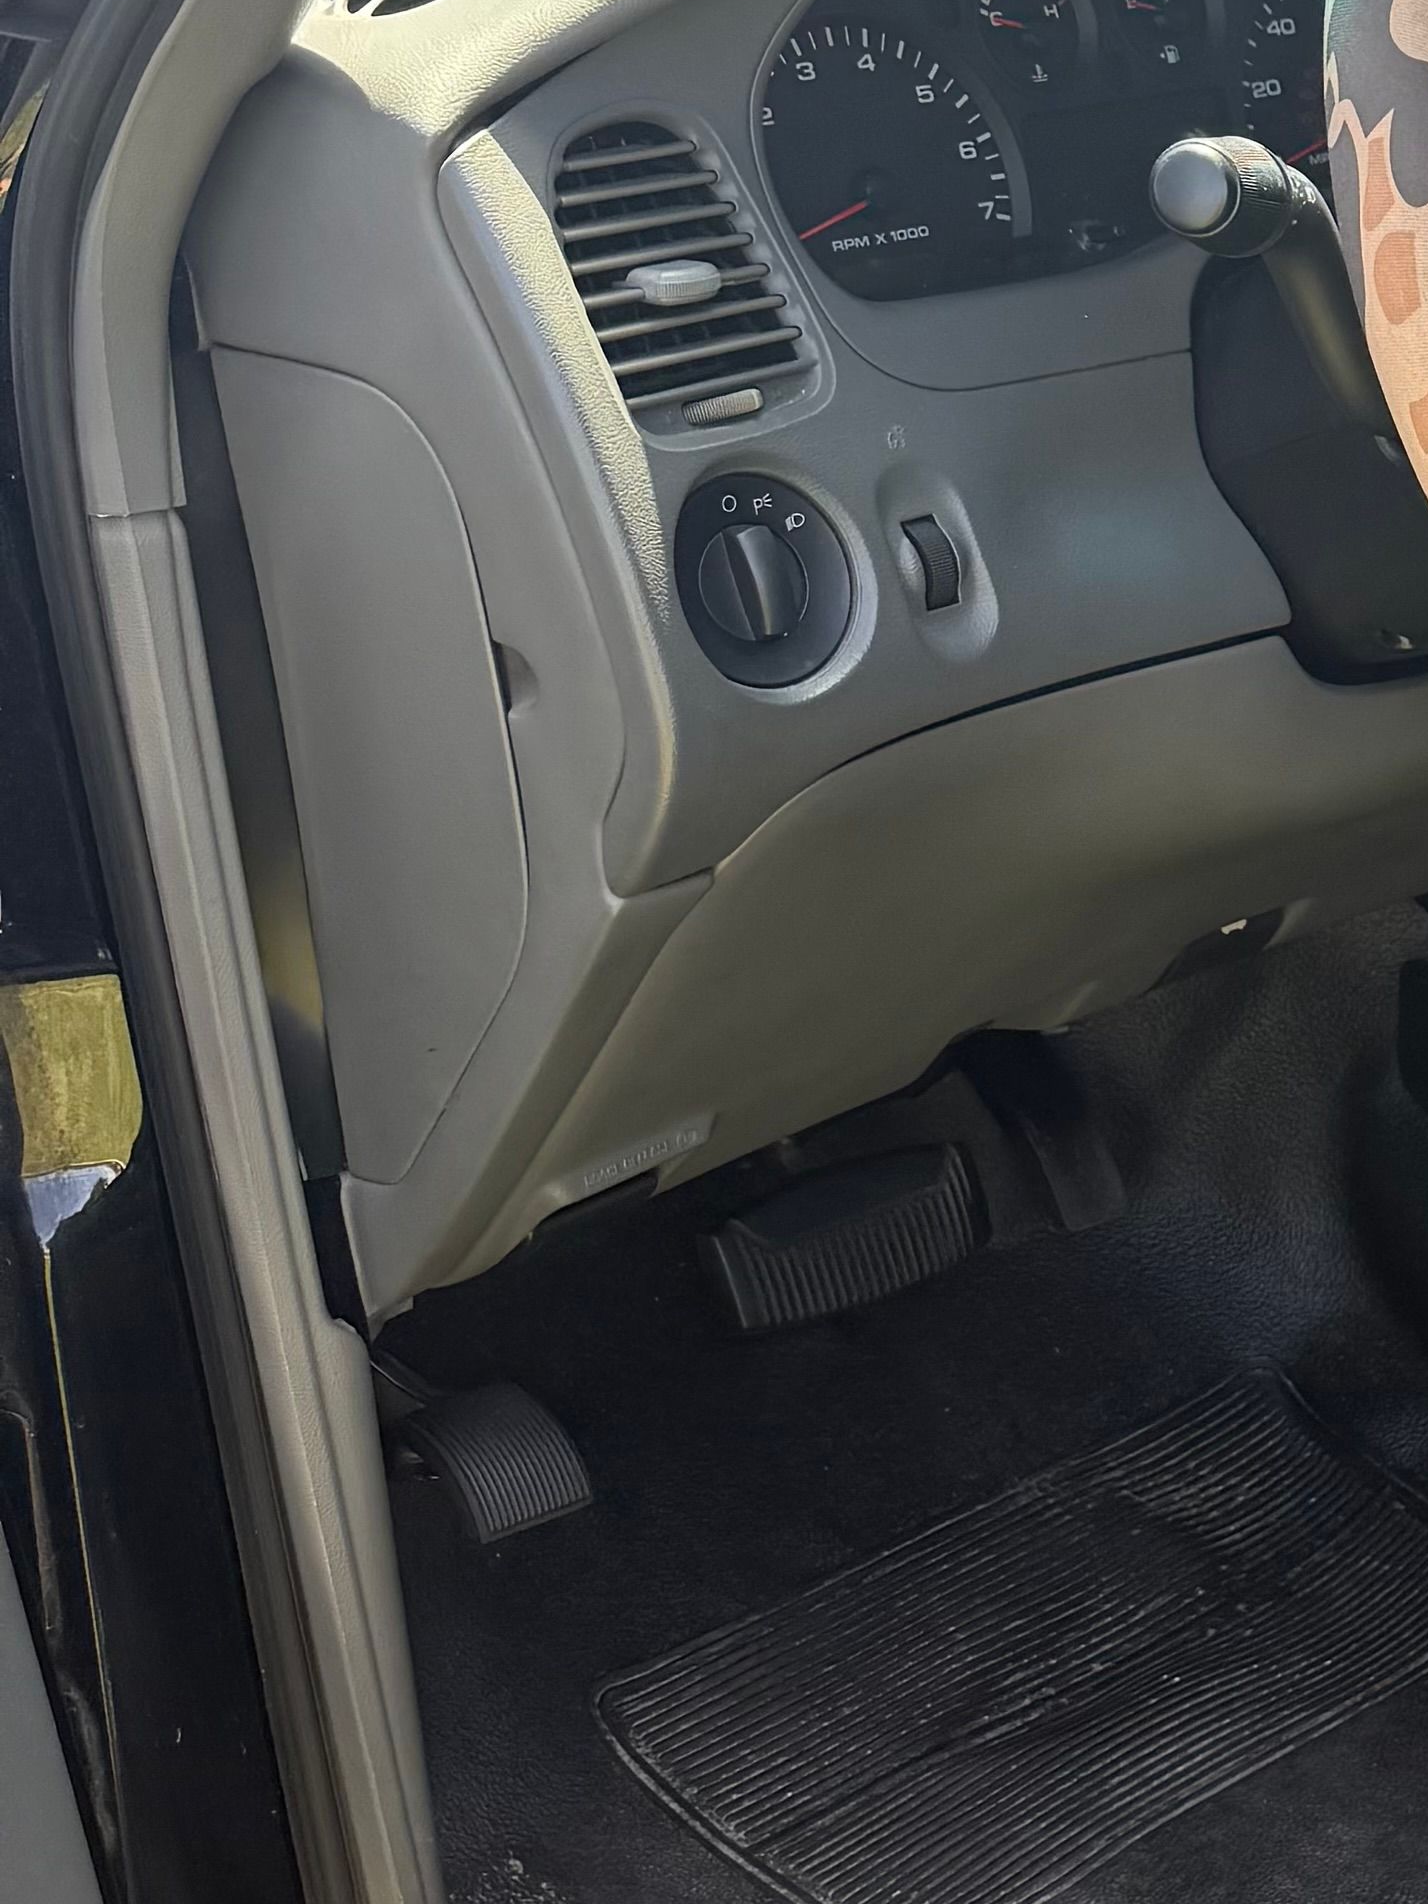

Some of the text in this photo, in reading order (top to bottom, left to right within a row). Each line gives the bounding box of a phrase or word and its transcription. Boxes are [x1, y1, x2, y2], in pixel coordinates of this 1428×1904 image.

[1043, 3, 1060, 19] H
[1266, 17, 1297, 37] 40
[795, 61, 816, 81] 3
[857, 53, 876, 72] 4
[915, 84, 935, 104] 5
[1251, 78, 1282, 99] 20
[958, 140, 978, 160] 6
[977, 201, 995, 221] 7
[832, 233, 870, 252] RPM
[889, 225, 930, 241] 1000
